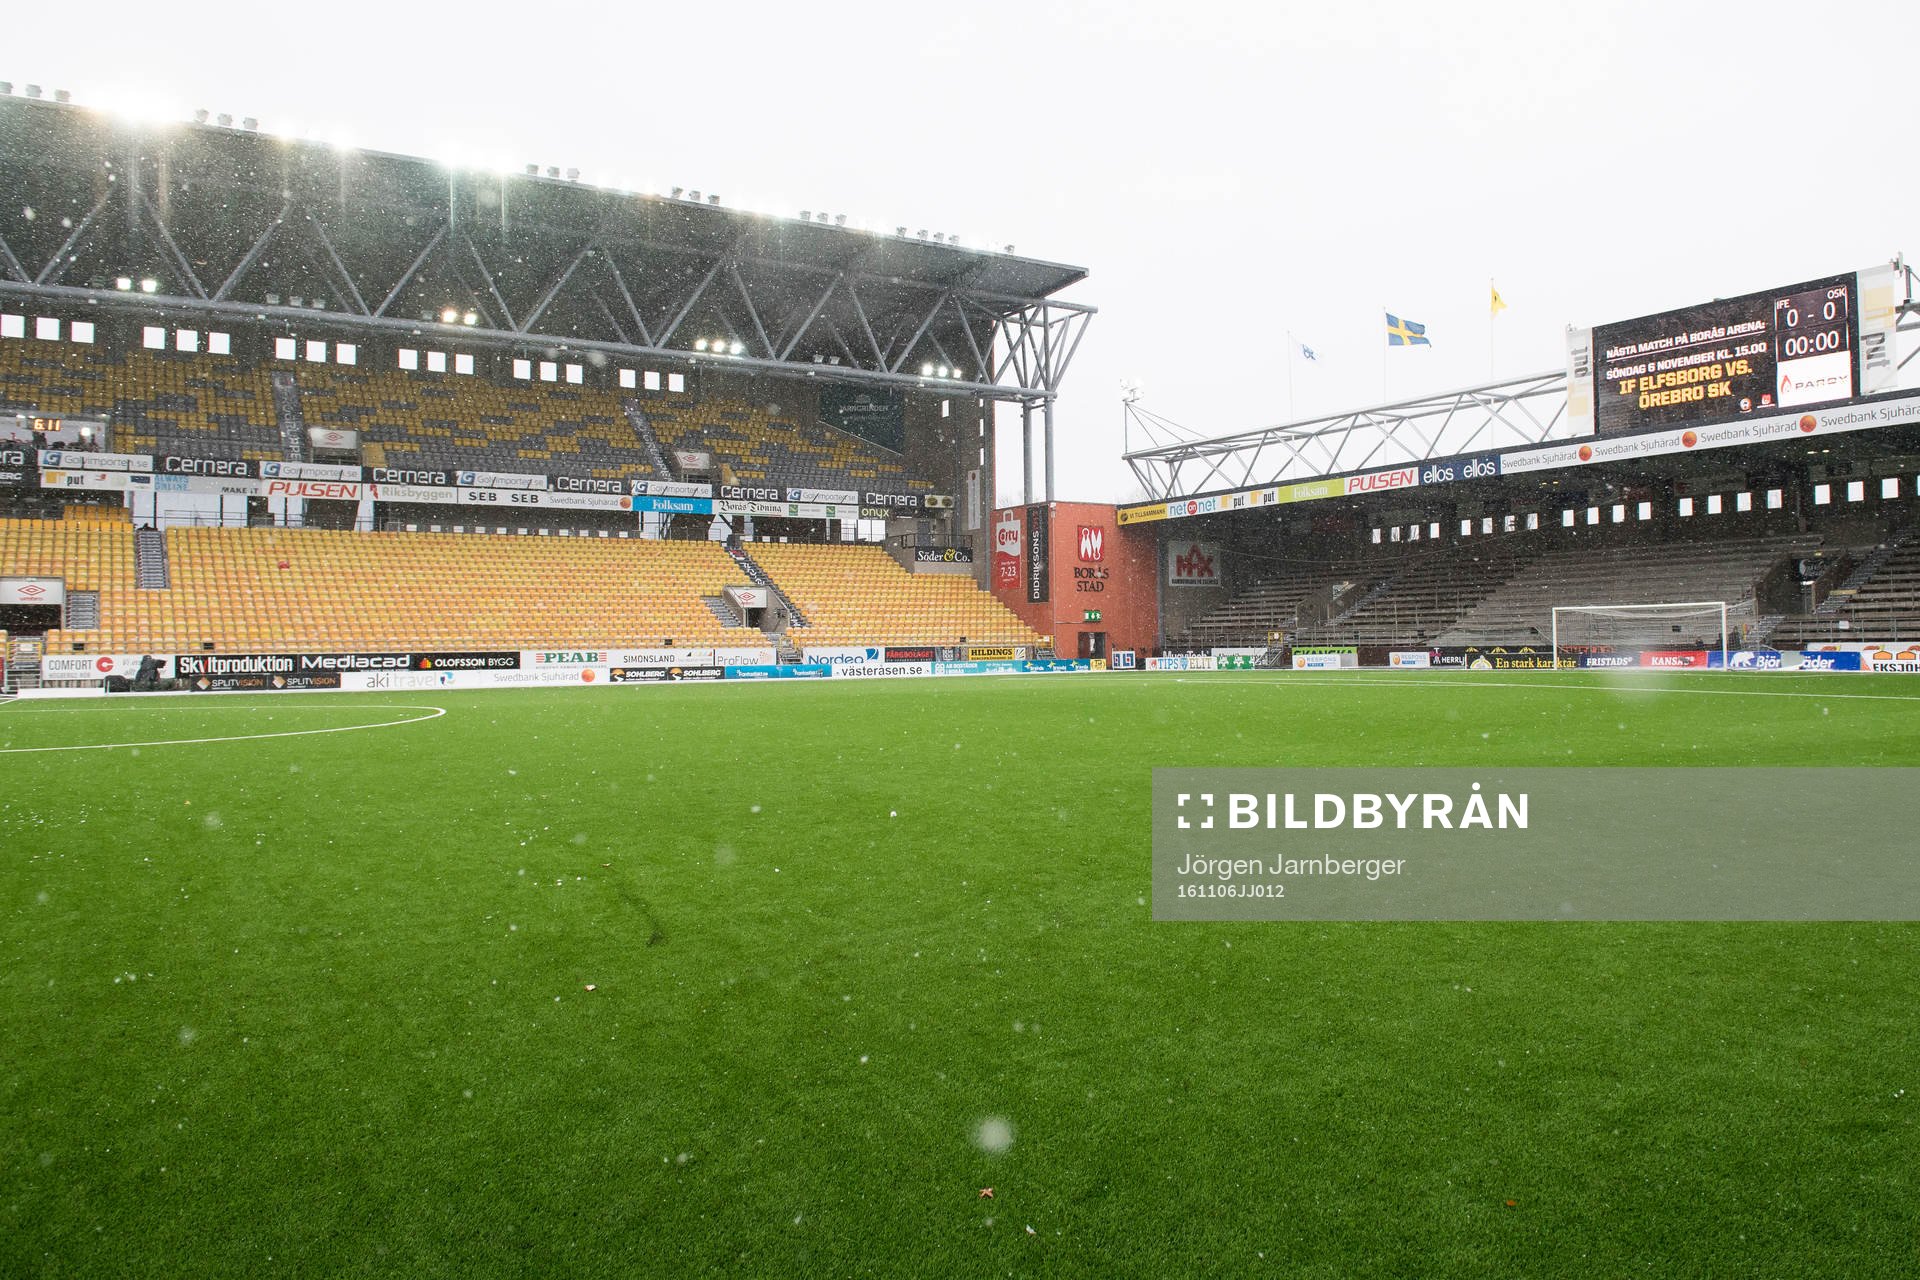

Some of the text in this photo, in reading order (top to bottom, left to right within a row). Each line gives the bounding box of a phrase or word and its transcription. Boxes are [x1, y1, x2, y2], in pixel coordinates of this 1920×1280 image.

[1776, 299, 1790, 310] IFE
[1786, 308, 1798, 327] 0
[1824, 302, 1836, 320] 0
[1606, 320, 1766, 360] NÄSTA MATCH PÅ BORÅS ARENA:
[1785, 330, 1840, 356] 00:00
[1606, 363, 1646, 380] SÖNDAG
[1648, 362, 1655, 373] 6
[1657, 351, 1715, 371] NOVEMBER
[1735, 342, 1767, 358] 15.00
[1619, 359, 1753, 395] IF ELFSBORG VS.
[1638, 380, 1732, 409] ÖREBRO SK
[1821, 410, 1877, 427] Swedbank
[1700, 420, 1797, 443] Swedbank Sjuhärad
[1594, 436, 1680, 456] Swedbank Sjuhärad
[1502, 450, 1577, 469] Swedbank Sjuhärad
[1423, 459, 1496, 484] ellos ellos
[1349, 469, 1414, 493] PULSEN
[268, 481, 357, 498] PULSEN
[382, 486, 453, 501] Riksbyggen
[1294, 486, 1328, 498] Folksam
[468, 491, 539, 504] SEB SEB
[549, 496, 586, 505] Swedbank
[1264, 491, 1275, 504] put
[652, 500, 694, 511] Folksam
[862, 507, 890, 519] onyx
[1074, 566, 1109, 579] BORÅS
[1077, 581, 1104, 592] STAD
[301, 654, 410, 669] Mediacad
[434, 658, 514, 667] OLOFSSON BYGG
[544, 652, 599, 664] PEAB
[623, 655, 675, 664] SIMONSLAND
[717, 656, 759, 665] ProFlow
[808, 654, 864, 664] Nordea
[1157, 658, 1179, 669] TIPS
[1496, 657, 1577, 668] En stark karktär
[49, 660, 92, 670] COMFORT
[842, 664, 923, 676] västeråsen.se
[212, 678, 263, 687] SPLITVISION
[366, 673, 390, 688] aki
[494, 672, 540, 682] Swedbank
